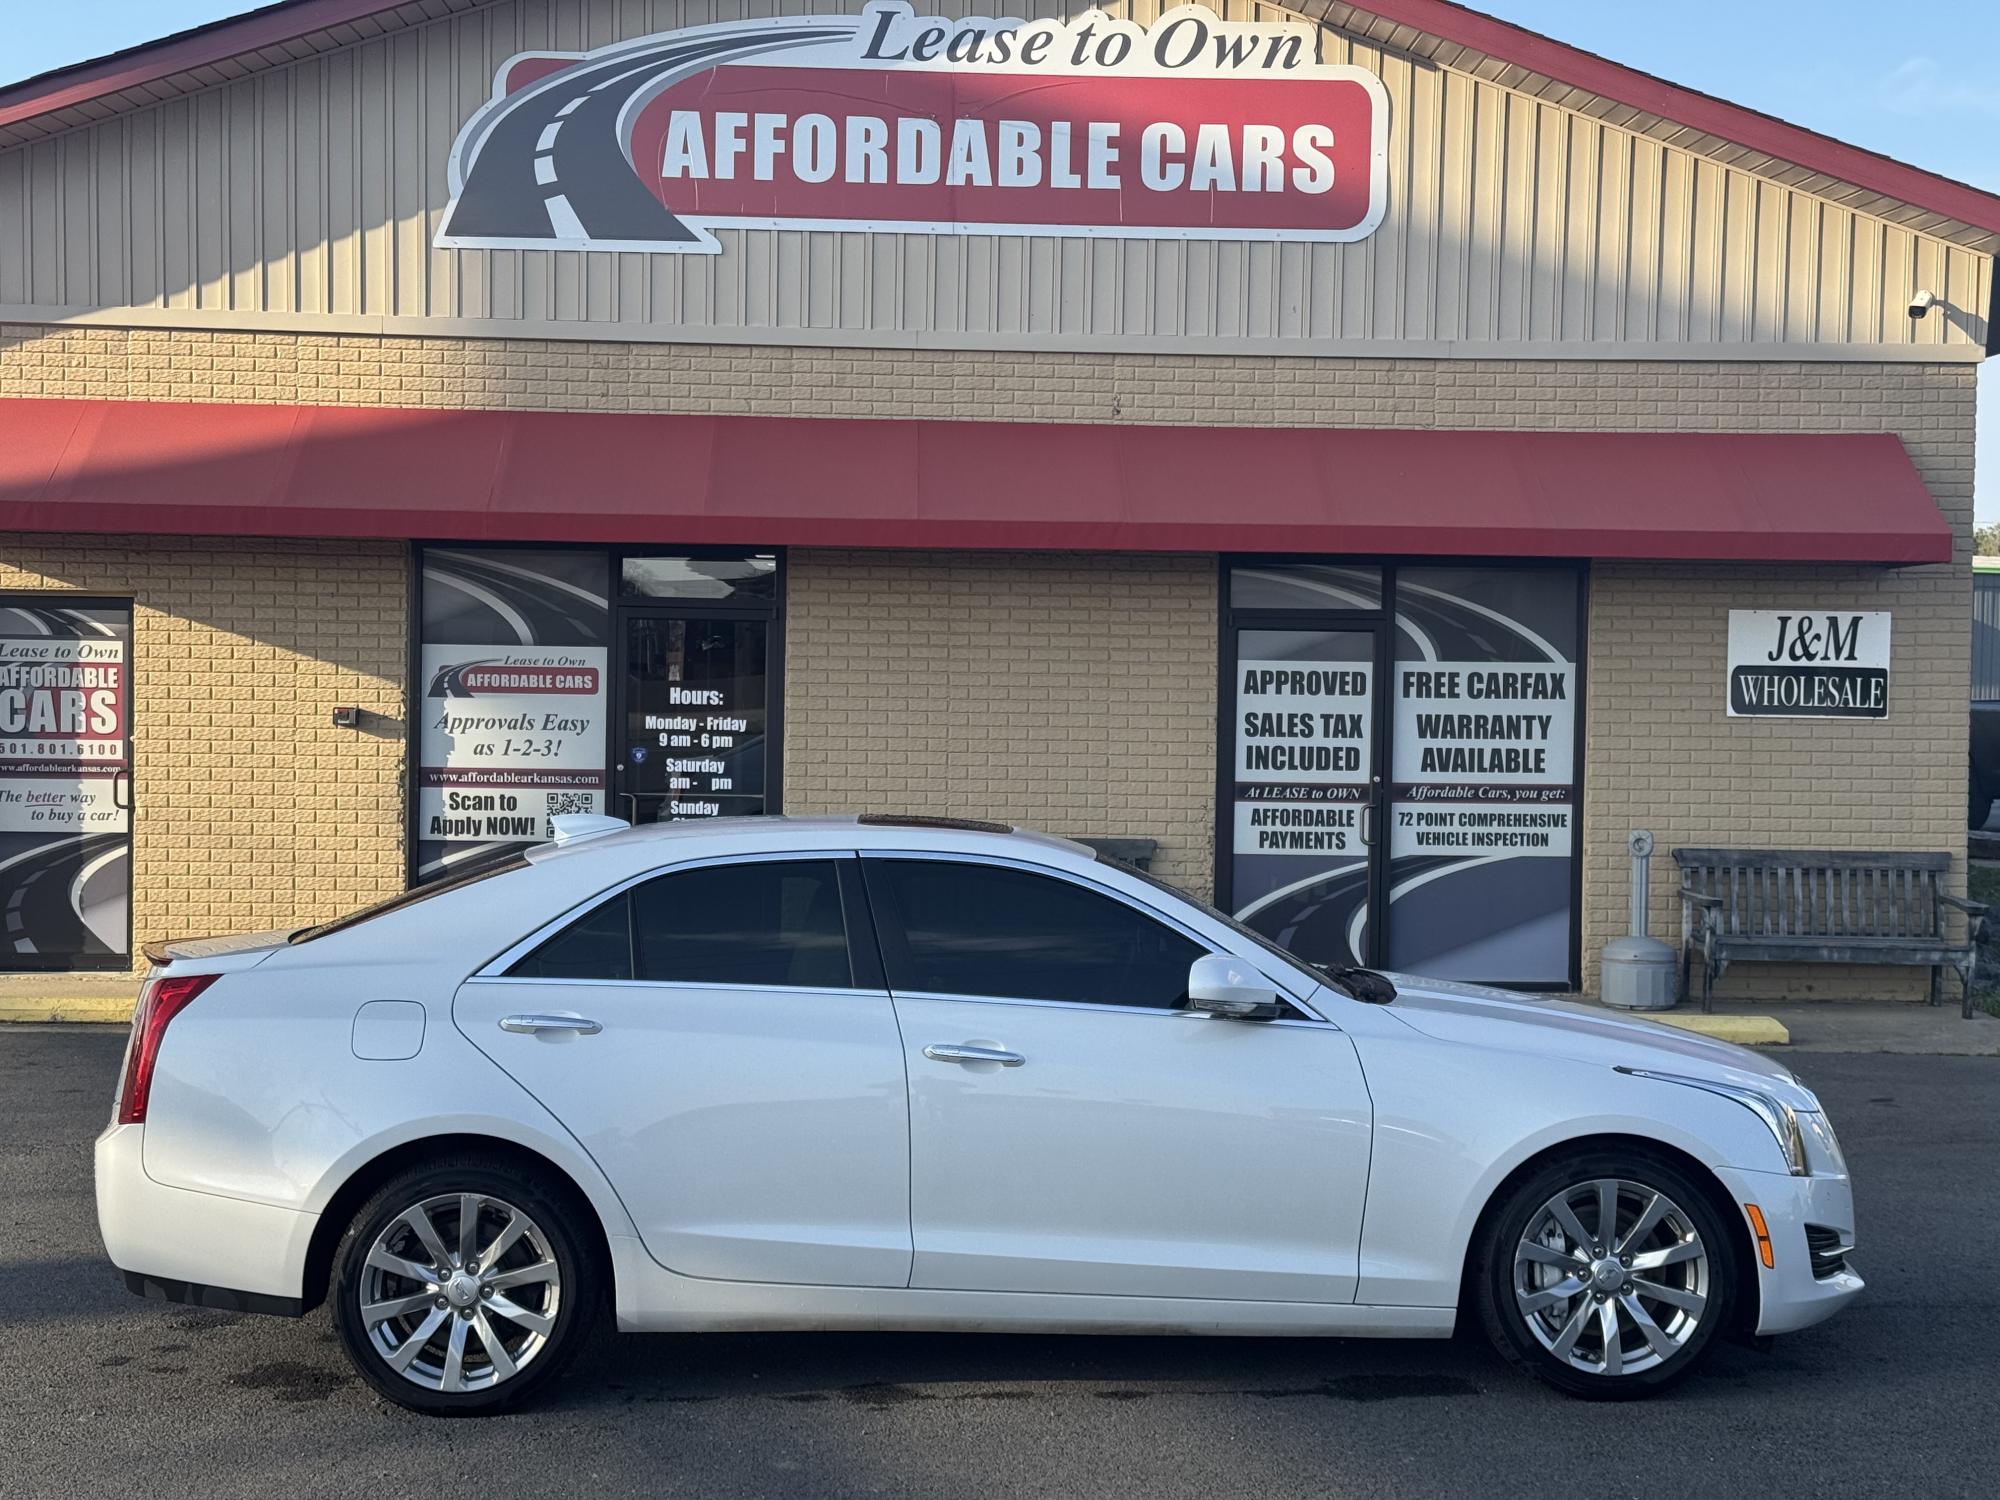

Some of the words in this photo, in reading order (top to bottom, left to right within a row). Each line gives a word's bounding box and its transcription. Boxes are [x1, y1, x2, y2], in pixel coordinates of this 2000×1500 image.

[861, 10, 1050, 65] Lease
[1075, 19, 1129, 69] to
[1154, 17, 1303, 70] Own
[661, 109, 1122, 190] AFFORDABLE
[1141, 120, 1337, 195] CARS
[1767, 616, 1863, 662] J&M
[0, 643, 49, 658] Lease
[55, 646, 71, 658] to
[78, 644, 119, 659] Own
[504, 655, 539, 666] Lease
[543, 656, 554, 666] to
[558, 656, 586, 667] Own
[0, 666, 119, 688] AFFORDABLE
[467, 673, 553, 688] AFFORDABLE
[555, 675, 593, 689] CARS
[1243, 670, 1367, 696] APPROVED
[1402, 672, 1460, 699] FREE
[1467, 672, 1566, 700] CARFAX
[669, 687, 724, 705] Hours:
[1738, 675, 1884, 709] WHOLESALE
[0, 689, 118, 734] CARS
[433, 712, 536, 734] Approvals
[541, 713, 590, 736] Easy
[645, 716, 697, 731] Monday
[706, 717, 747, 732] Friday
[1244, 712, 1314, 738] SALES
[1320, 713, 1364, 739] TAX
[1416, 714, 1552, 740] WARRANTY
[0, 742, 117, 755] 501.801.6100
[473, 743, 495, 756] as
[503, 739, 562, 757] 1-2-3!
[659, 733, 668, 747] 9
[670, 735, 691, 747] am
[700, 733, 710, 747] 6
[712, 736, 733, 748] pm
[666, 758, 725, 774] Saturday
[1246, 745, 1360, 771] INCLUDED
[1420, 747, 1546, 773] AVAILABLE
[0, 763, 121, 773] ww.affordablearkansas.com
[429, 772, 599, 784] www.affordablearkansas.com
[669, 777, 690, 789] am
[711, 778, 732, 791] pm
[0, 790, 22, 802] The
[26, 790, 66, 803] better
[70, 793, 96, 806] way
[449, 792, 494, 811] Scan
[499, 794, 518, 812] to
[1245, 787, 1260, 798] At
[1262, 787, 1309, 799] LEASE
[1311, 789, 1323, 799] to
[1326, 788, 1361, 800] OWN
[1407, 786, 1475, 800] Affordable
[1478, 786, 1511, 800] Cars,
[1513, 790, 1538, 801] you
[1541, 788, 1566, 801] get:
[31, 810, 45, 821] to
[48, 808, 73, 823] buy
[77, 812, 86, 821] a
[90, 809, 119, 821] car!
[670, 801, 719, 816] Sunday
[1250, 808, 1355, 827] AFFORDABLE
[430, 816, 482, 837] Apply
[486, 816, 535, 836] NOW!
[1398, 812, 1413, 827] 72
[1416, 812, 1455, 827] POINT
[1458, 813, 1567, 828] COMPREHENSIVE
[1259, 831, 1346, 850] PAYMENTS
[1416, 831, 1468, 846] VEHICLE
[1471, 832, 1549, 847] INSPECTION
